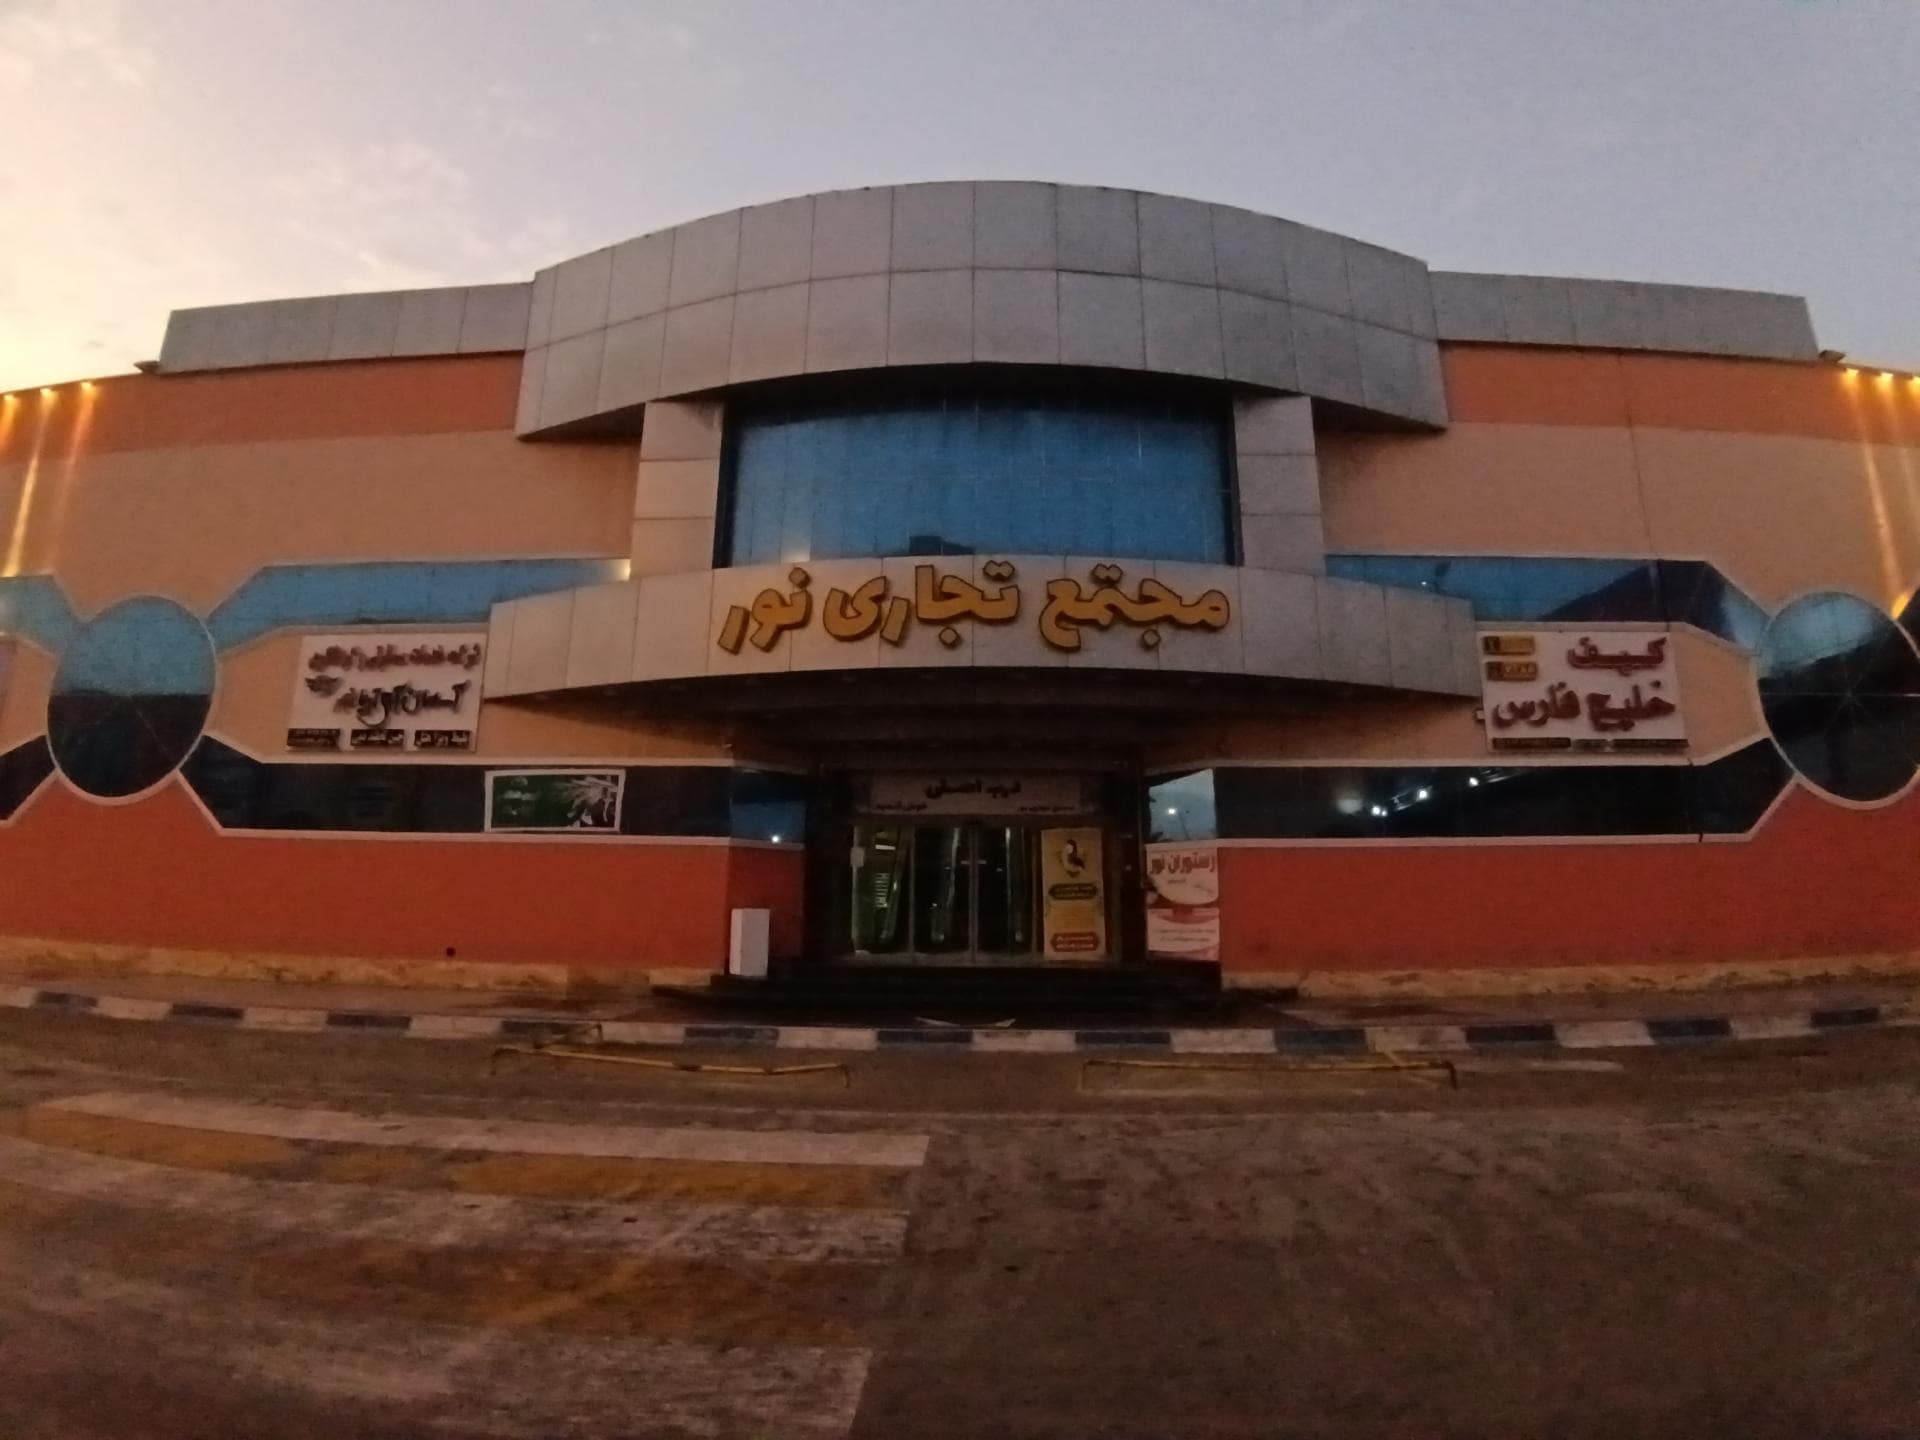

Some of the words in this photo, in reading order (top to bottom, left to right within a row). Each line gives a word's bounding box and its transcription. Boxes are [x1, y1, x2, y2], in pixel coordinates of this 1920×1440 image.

[717, 566, 813, 654] نور
[822, 560, 1022, 648] تجاری
[1038, 563, 1231, 653] مجتمع
[1567, 637, 1667, 676] کیف
[1493, 681, 1580, 728] فارس
[1586, 680, 1676, 731] خلیج
[1168, 852, 1215, 874] رستوران
